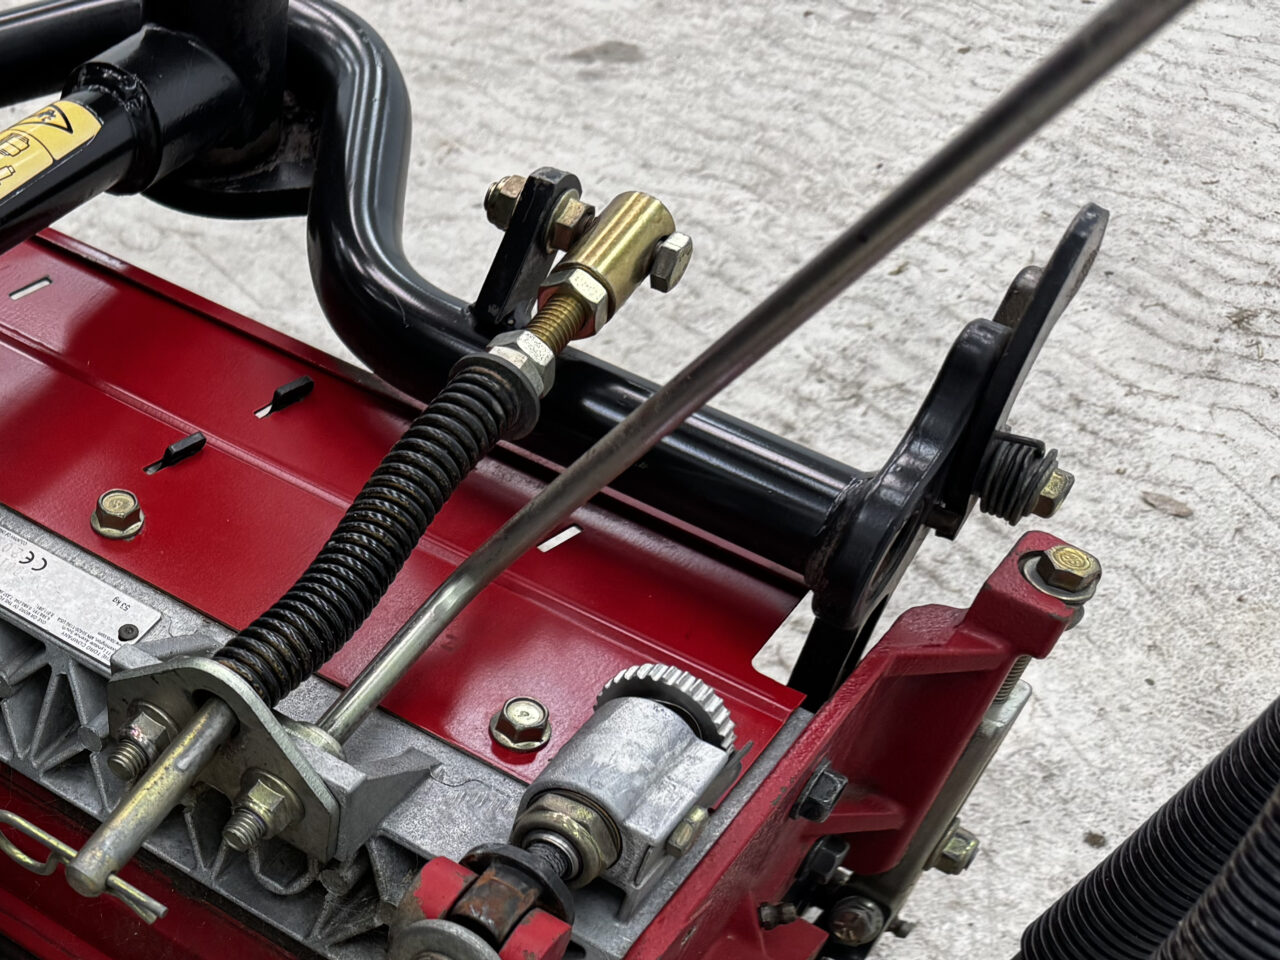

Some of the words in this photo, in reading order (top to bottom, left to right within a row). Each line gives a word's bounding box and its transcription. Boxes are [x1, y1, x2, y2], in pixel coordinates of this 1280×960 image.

[18, 551, 48, 571] CE
[111, 596, 122, 606] kg
[120, 603, 132, 612] 53
[60, 630, 87, 647] COMPANY
